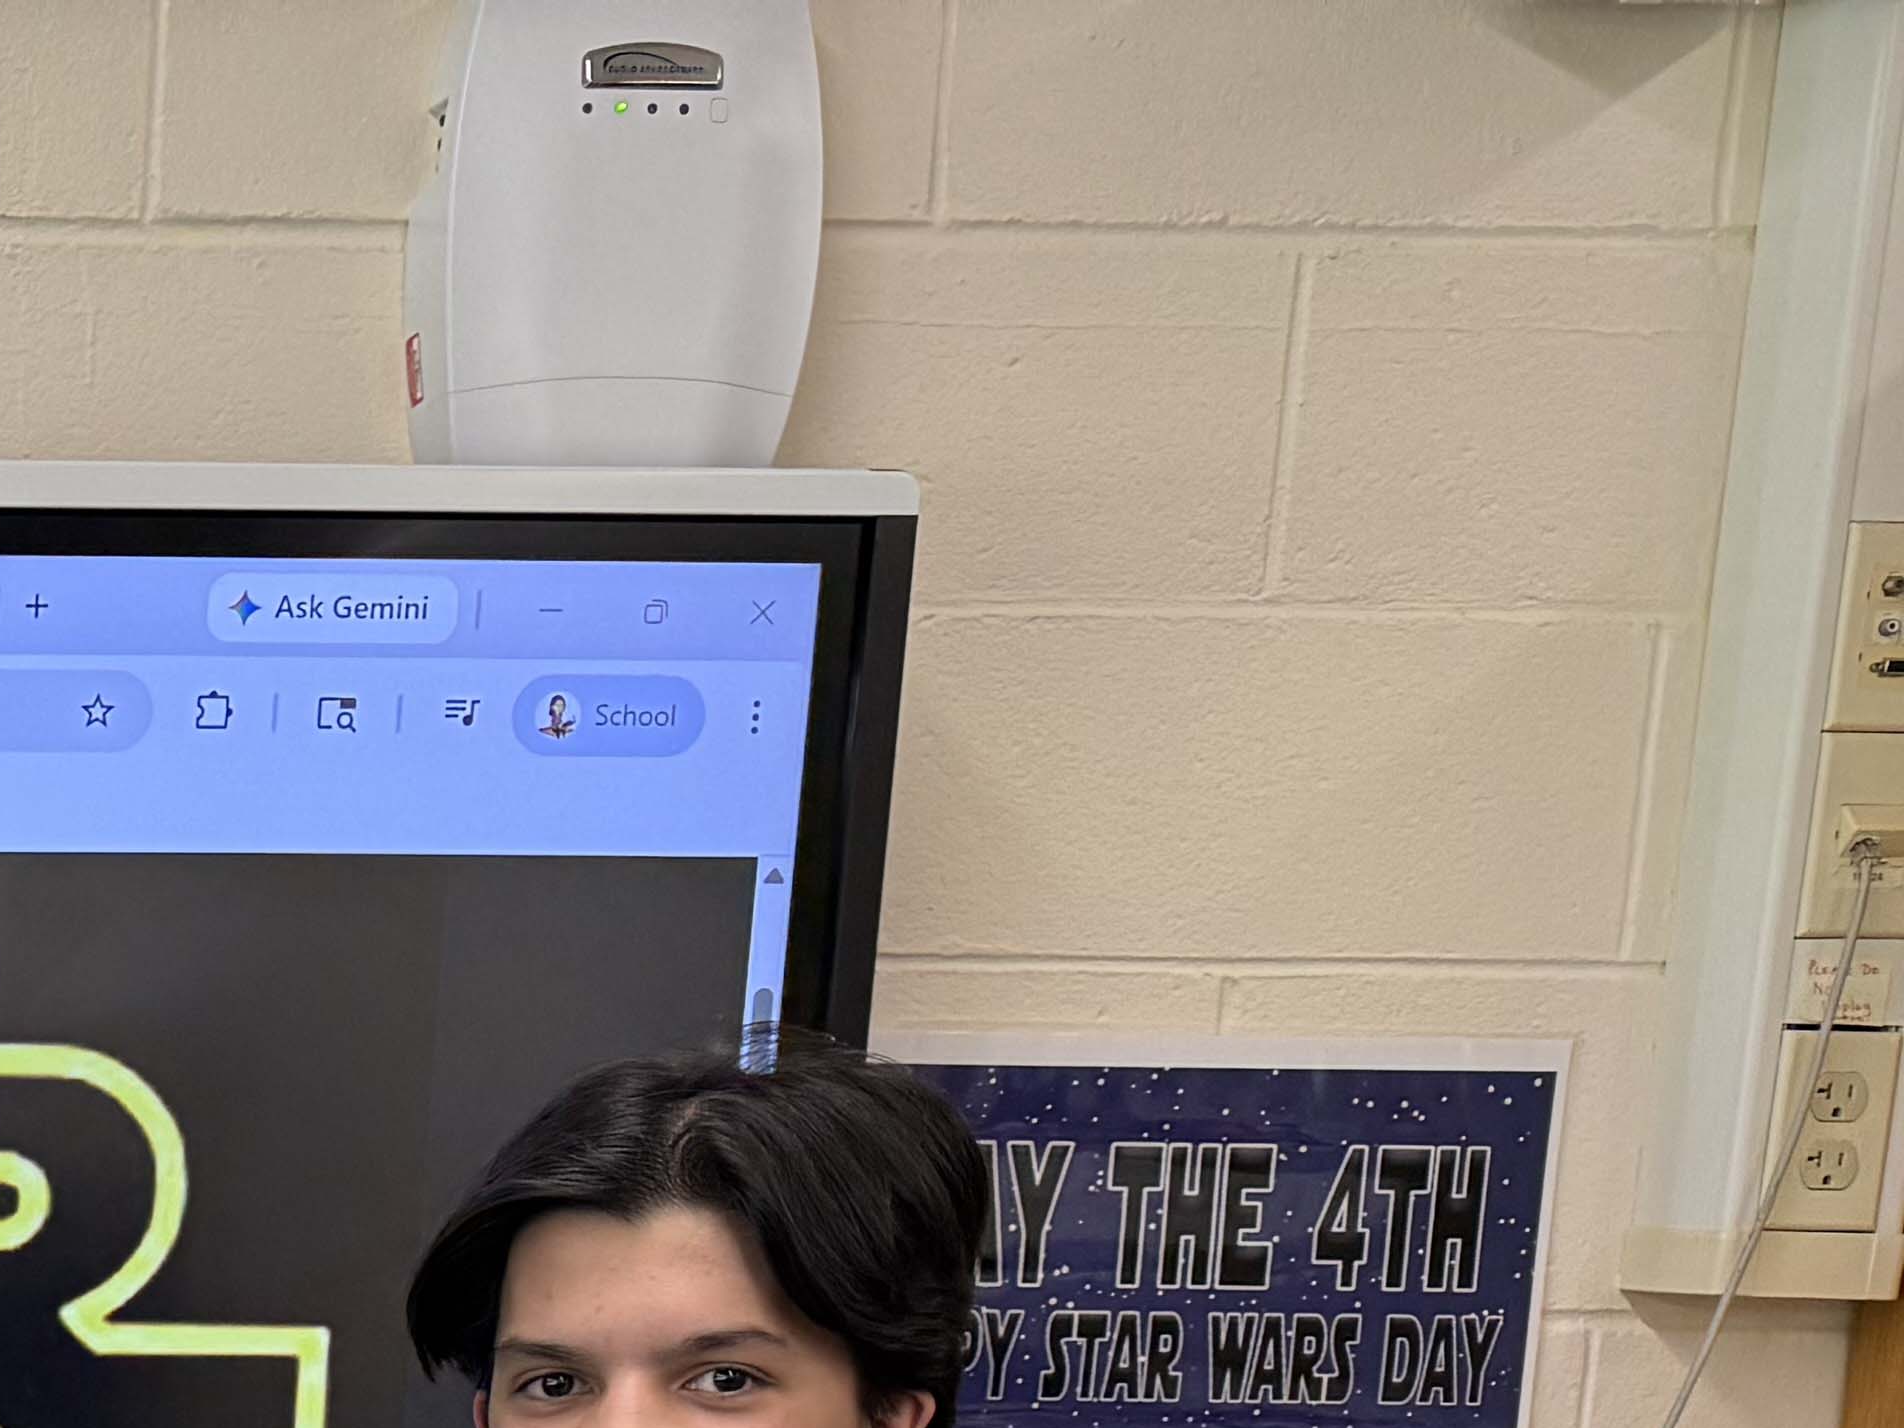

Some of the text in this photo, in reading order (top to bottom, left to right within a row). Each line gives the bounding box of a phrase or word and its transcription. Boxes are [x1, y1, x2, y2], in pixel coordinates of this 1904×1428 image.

[274, 594, 430, 620] Ask Gemini
[595, 703, 677, 728] School
[1107, 1141, 1278, 1291] THE
[1310, 1143, 1492, 1293] 4TH
[1037, 1309, 1185, 1403] STAR
[1207, 1311, 1362, 1405] WARS
[1377, 1314, 1504, 1406] DAY
